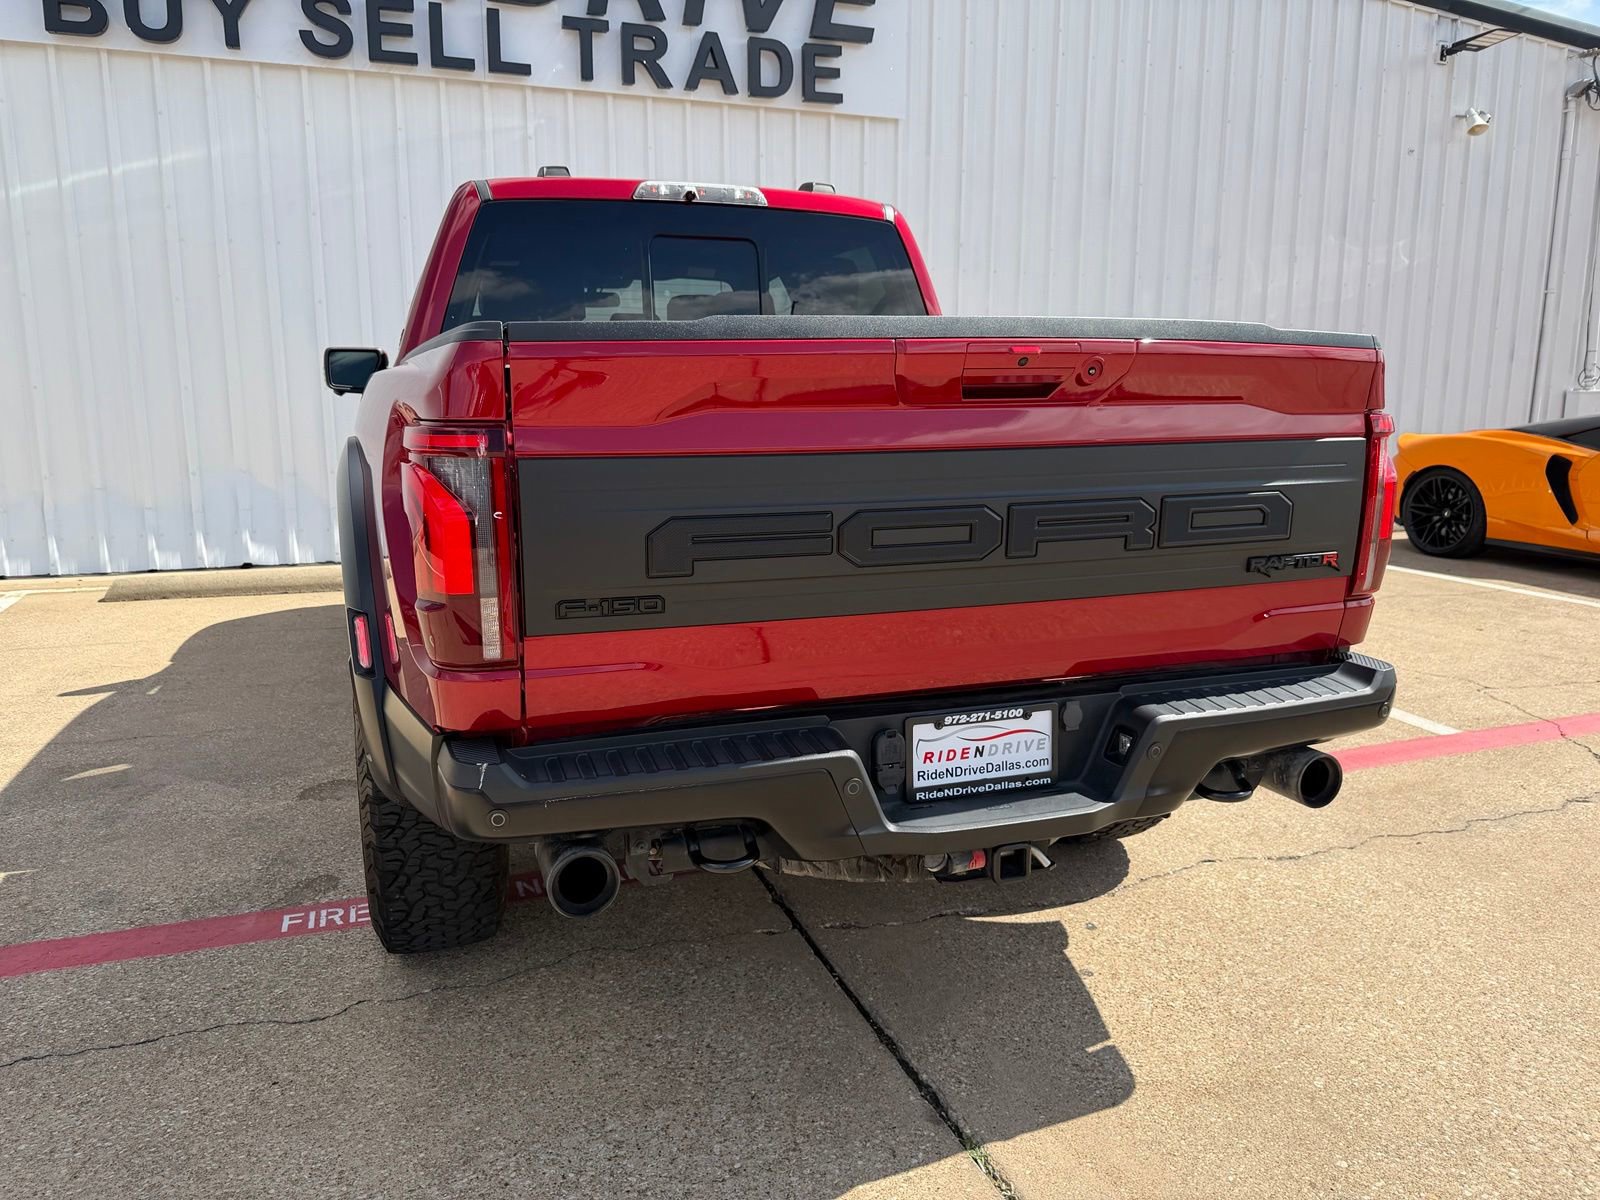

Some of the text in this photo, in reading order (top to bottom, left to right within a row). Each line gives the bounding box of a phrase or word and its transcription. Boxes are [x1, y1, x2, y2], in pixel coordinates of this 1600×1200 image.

[44, 0, 243, 50] BUY
[298, 0, 533, 76] SELL
[561, 15, 844, 104] TRADE
[645, 490, 1294, 580] FORD
[1245, 550, 1341, 578] RAPTOR
[555, 594, 666, 620] F-150
[943, 708, 1024, 725] 972-271-5100
[917, 756, 1050, 782] RideNDriveDallas.com
[915, 777, 1052, 801] RideNDriveDallas.com
